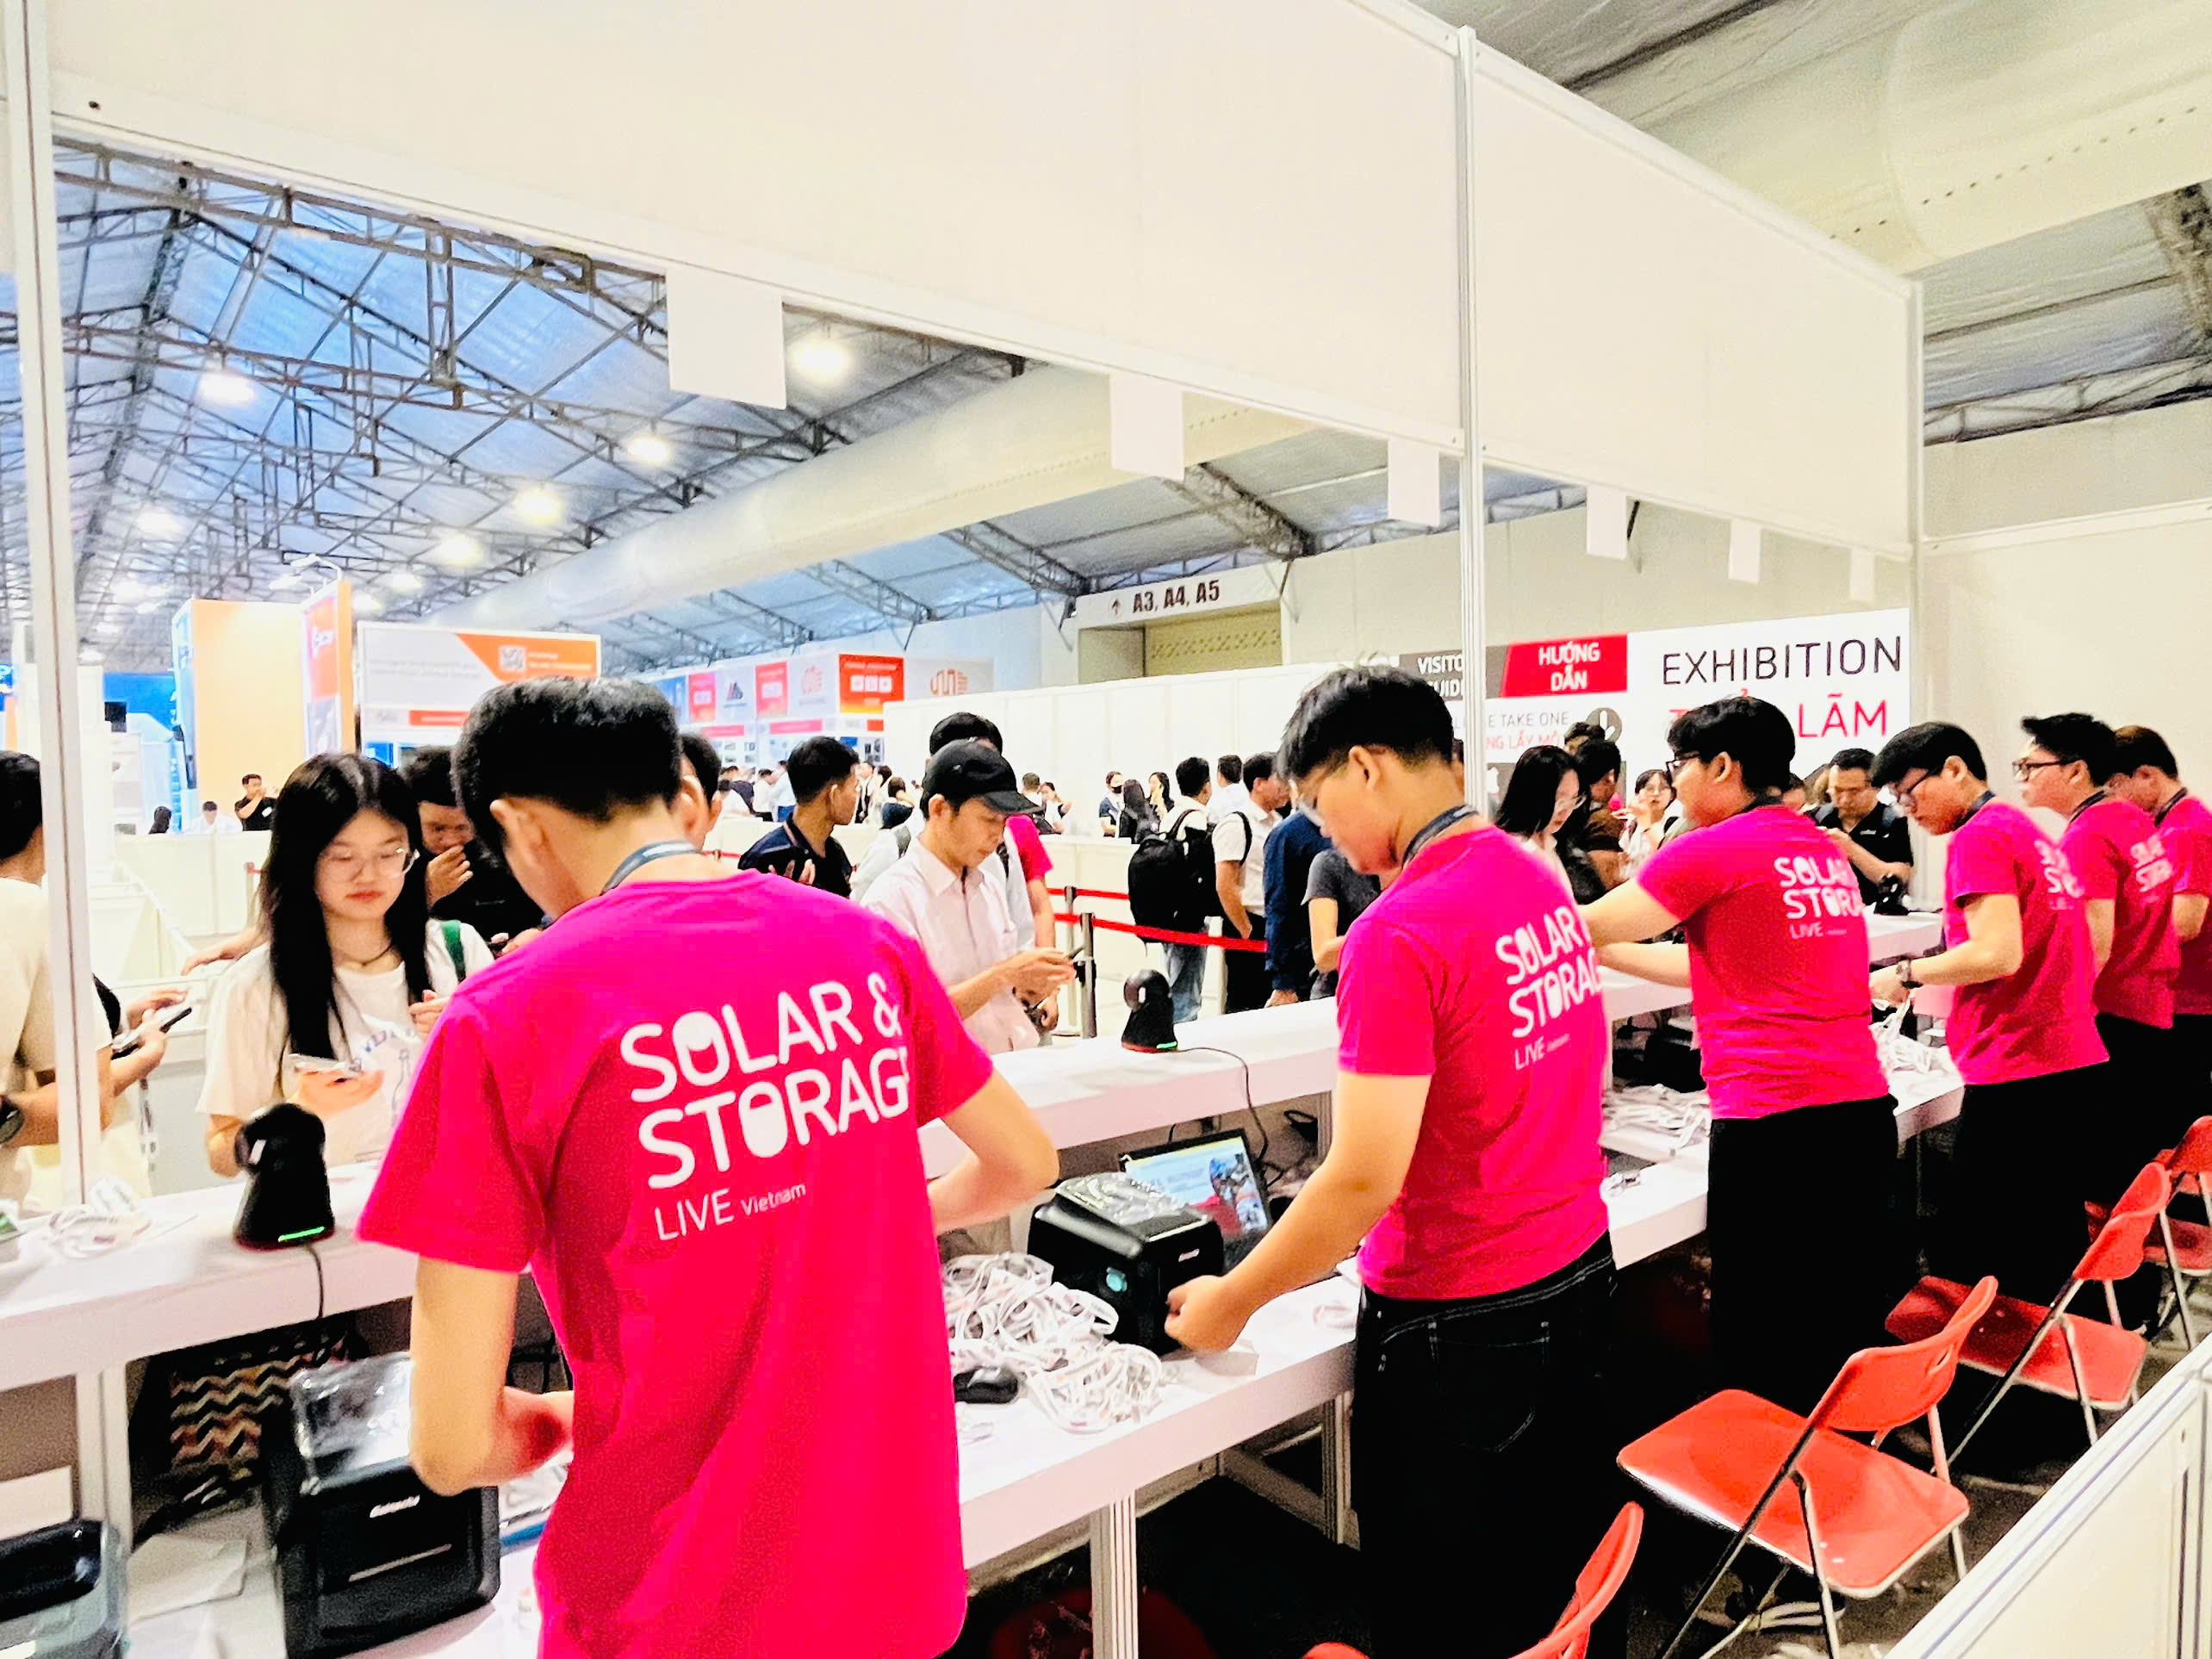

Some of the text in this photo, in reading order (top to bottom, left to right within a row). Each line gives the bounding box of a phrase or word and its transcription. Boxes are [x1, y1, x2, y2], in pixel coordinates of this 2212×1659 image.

[1133, 580, 1220, 613] A3, A4, A5
[1417, 654, 1463, 674] VISITO
[1538, 640, 1601, 666] HƯỚNG
[1662, 636, 1901, 685] EXHIBITION
[1426, 679, 1463, 697] UID
[1501, 712, 1535, 729] TAKE
[1539, 709, 1569, 728] ONE
[1798, 692, 1886, 738] LÃM
[1495, 906, 1583, 985] SOLAR
[1790, 921, 1824, 939] LIVE
[620, 972, 903, 1103] SOLAR &
[1514, 1036, 1545, 1071] LIVE
[638, 1046, 910, 1189] STORAG
[655, 1184, 806, 1241] LIVE Vietnam
